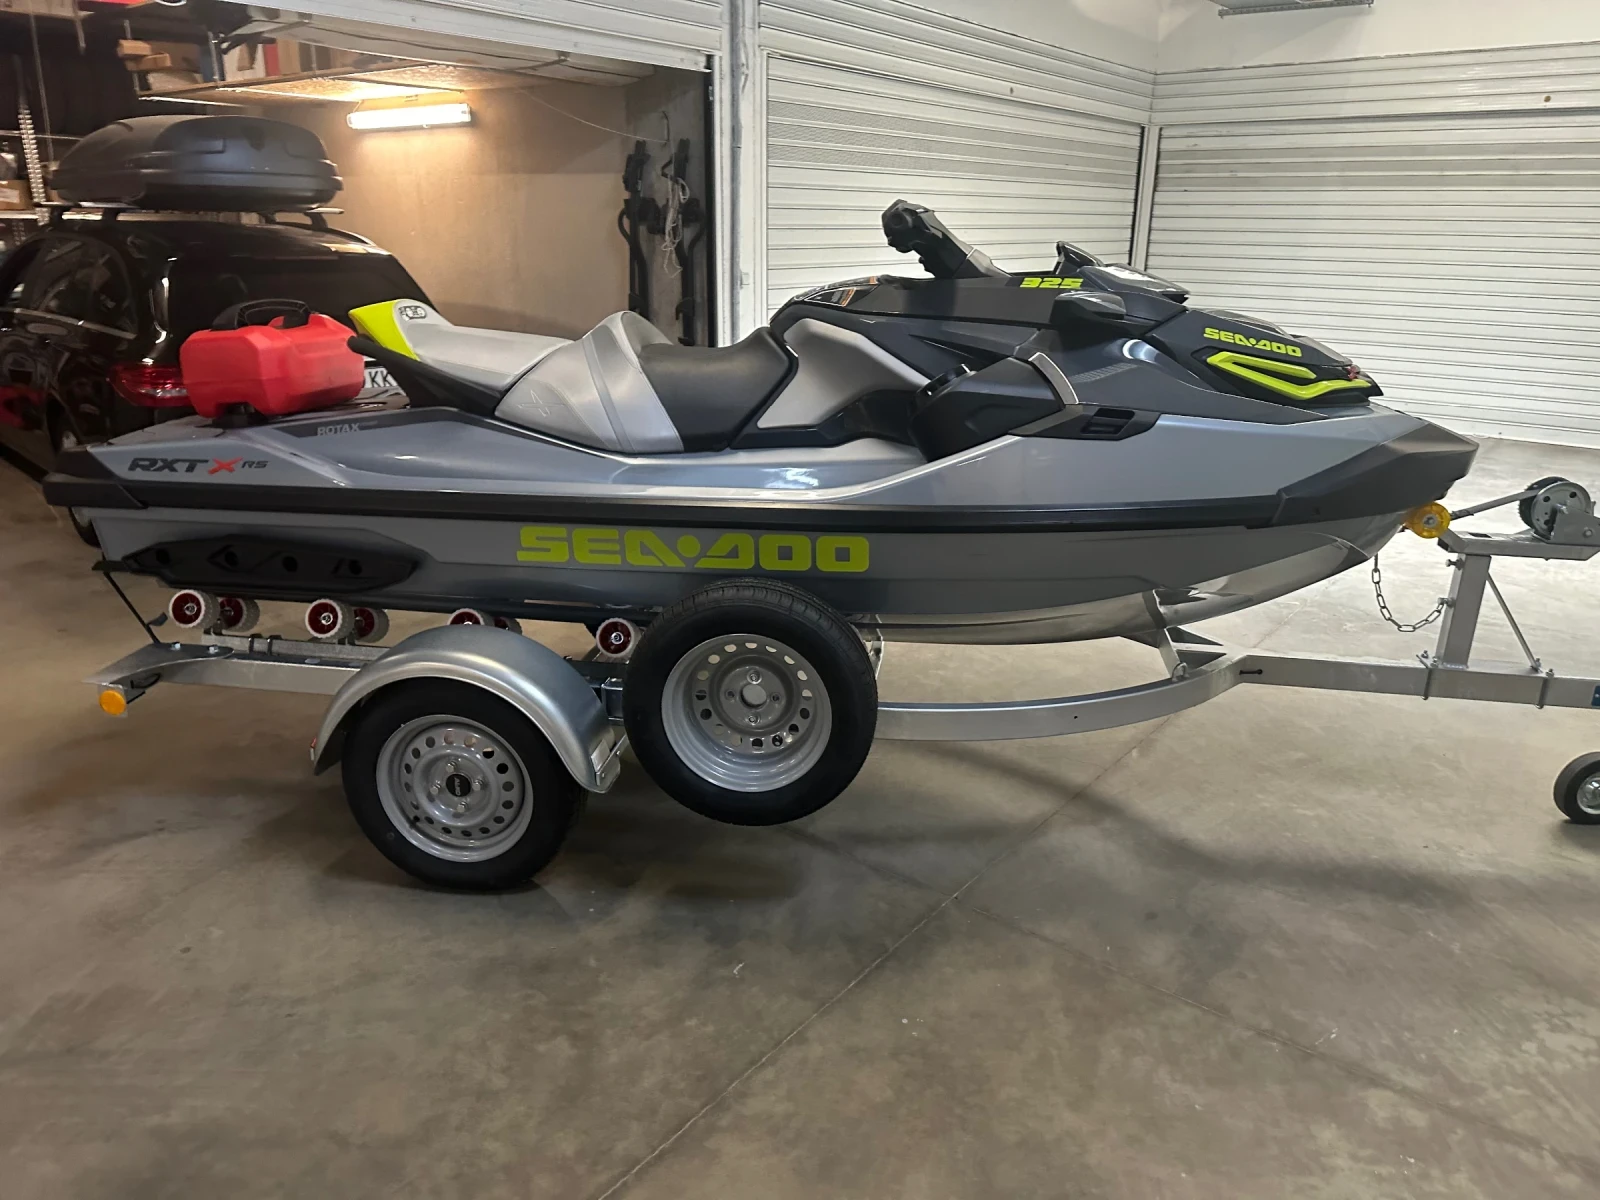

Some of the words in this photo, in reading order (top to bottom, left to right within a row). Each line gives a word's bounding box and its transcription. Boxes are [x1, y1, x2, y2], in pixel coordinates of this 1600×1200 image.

[1020, 277, 1084, 289] 325
[317, 422, 360, 437] ROTAX
[128, 457, 209, 473] RXT
[207, 456, 243, 475] X
[241, 460, 269, 469] RS
